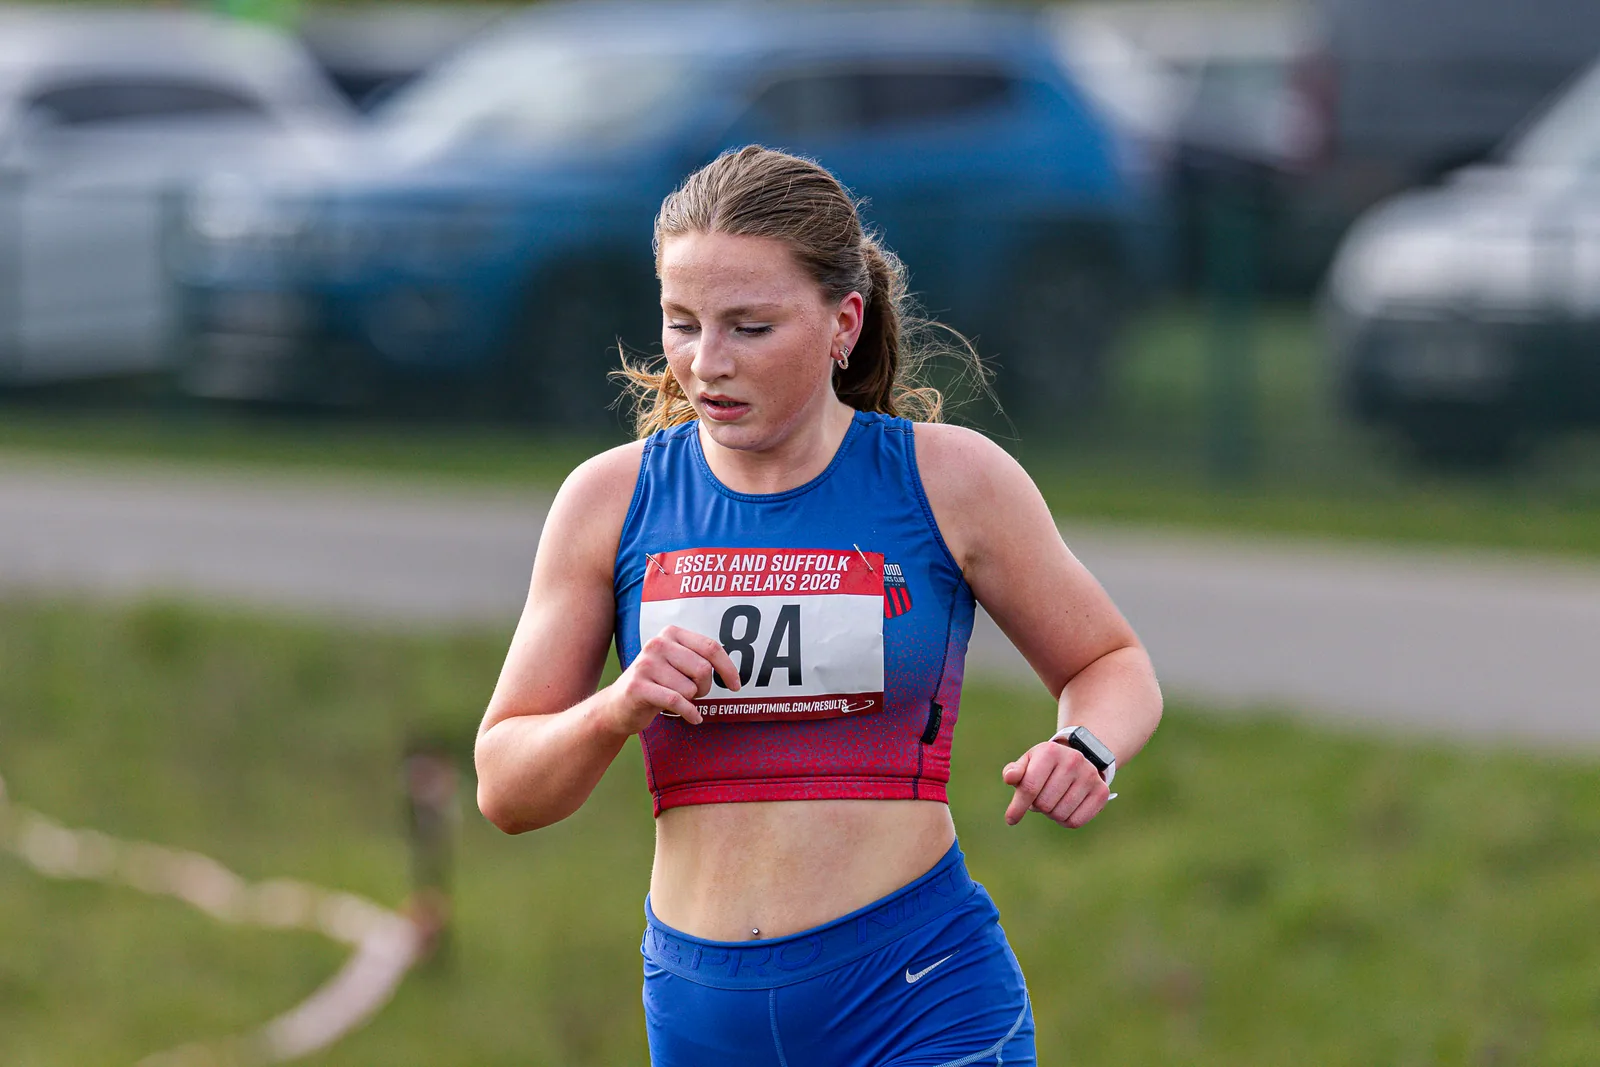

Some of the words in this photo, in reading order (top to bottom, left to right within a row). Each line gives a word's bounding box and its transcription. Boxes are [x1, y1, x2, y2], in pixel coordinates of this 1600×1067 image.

[674, 555, 728, 574] ESSEX
[728, 554, 767, 573] AND
[770, 554, 851, 572] SUFFOLK
[679, 574, 727, 594] ROAD
[730, 573, 795, 592] RELAYS
[799, 573, 841, 591] 2026
[712, 604, 803, 689] 8A
[709, 704, 718, 716] @
[718, 699, 848, 715] EVENTCHIPTIMING.COM/RESULTS
[690, 935, 823, 977] PRO
